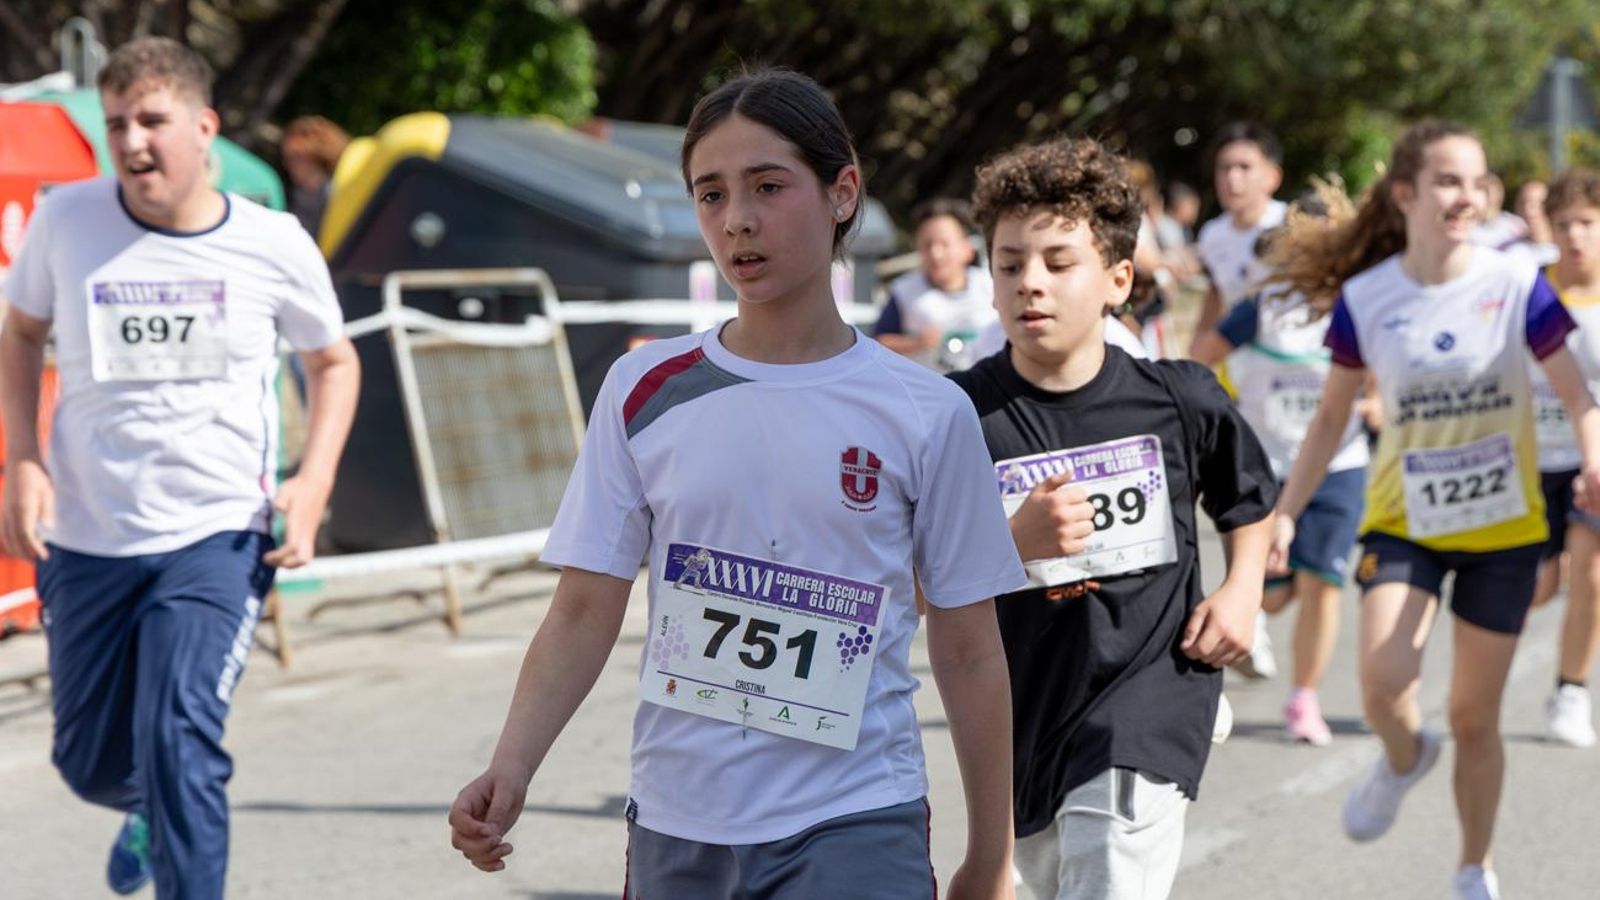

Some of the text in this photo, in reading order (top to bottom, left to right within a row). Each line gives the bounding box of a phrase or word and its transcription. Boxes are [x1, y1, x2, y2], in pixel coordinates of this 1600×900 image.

[121, 316, 195, 344] 697
[1083, 463, 1098, 478] LA
[1421, 468, 1506, 505] 1222
[1087, 487, 1146, 531] 89
[702, 556, 876, 605] XXXVI CARRERA ESCOLAR
[782, 586, 858, 617] LA GLORIA
[703, 607, 818, 680] 751
[735, 679, 766, 695] CRISTINA
